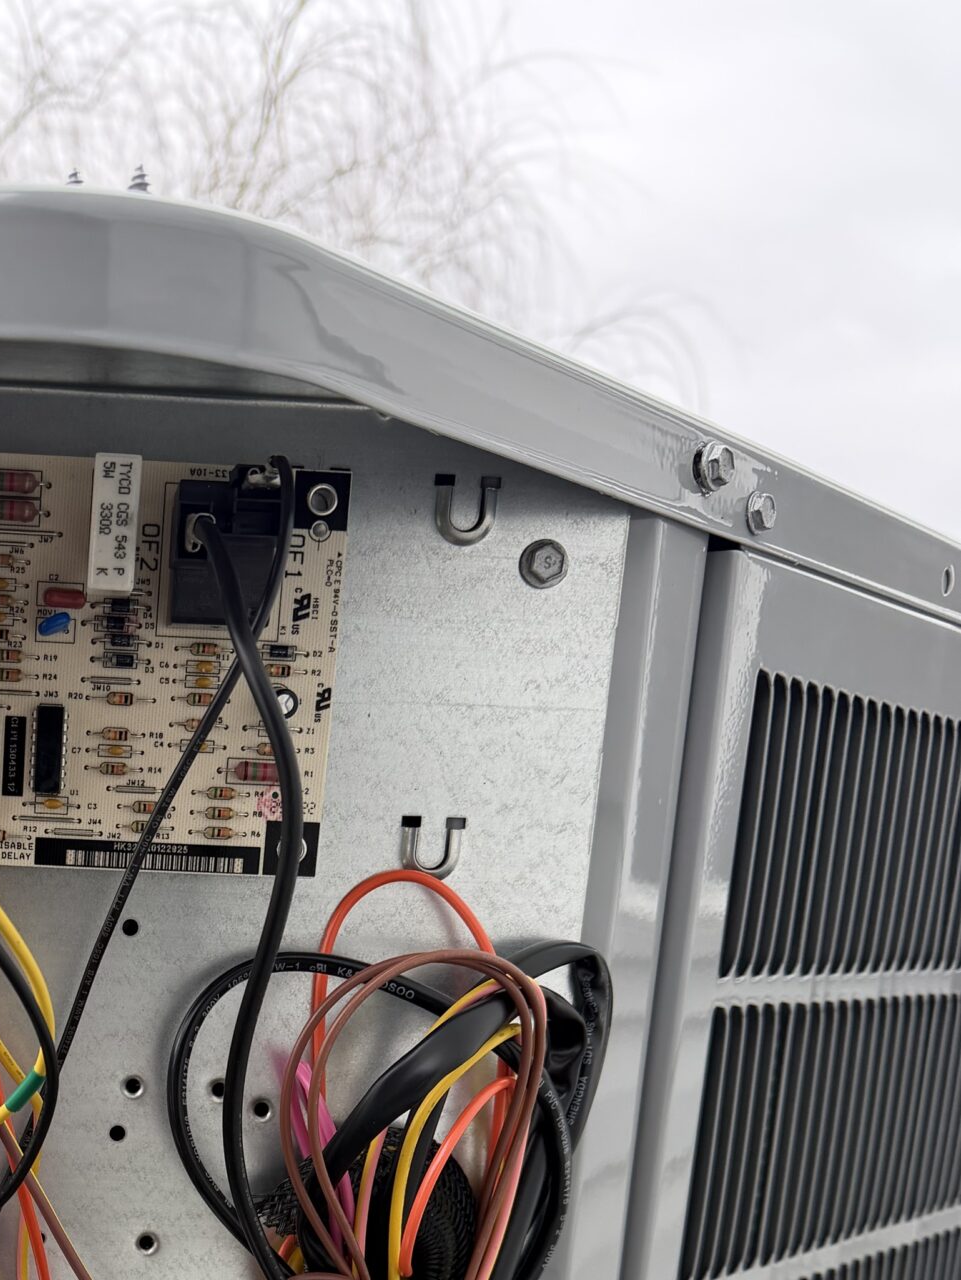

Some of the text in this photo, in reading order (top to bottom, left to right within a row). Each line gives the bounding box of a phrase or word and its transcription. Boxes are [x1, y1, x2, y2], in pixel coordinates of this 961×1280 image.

[102, 461, 117, 479] 5W
[115, 502, 130, 527] CGS
[114, 535, 127, 560] 543
[139, 523, 160, 572] OF2
[10, 566, 26, 574] R25
[96, 567, 108, 576] K
[113, 567, 125, 576] P
[327, 617, 339, 653] SST-A
[303, 770, 314, 778] R1
[1, 851, 32, 860] DELAY
[567, 1076, 589, 1126] SHENGDA
